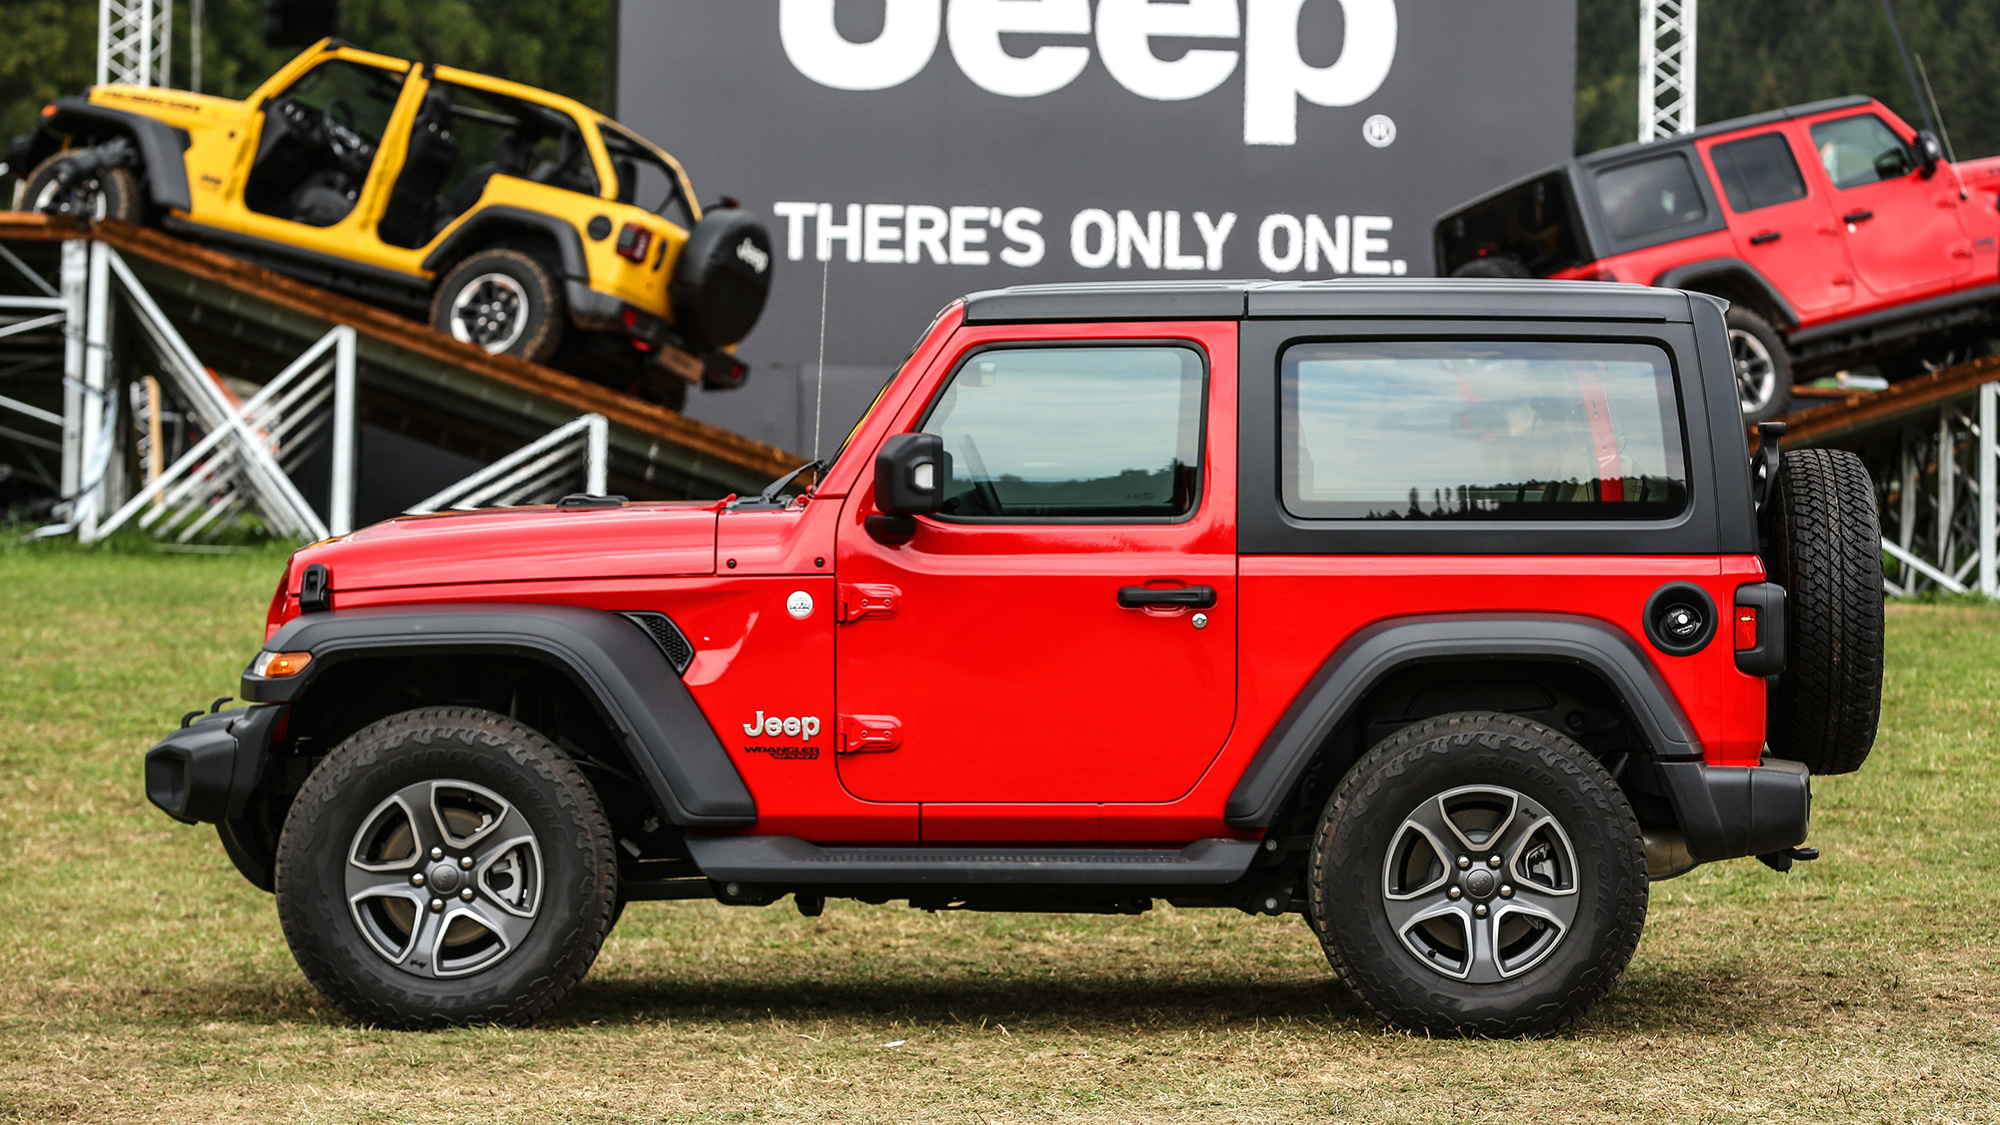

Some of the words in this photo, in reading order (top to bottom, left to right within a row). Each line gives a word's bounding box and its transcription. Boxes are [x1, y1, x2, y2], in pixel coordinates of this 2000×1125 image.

[736, 237, 769, 274] Jeep
[773, 201, 1046, 269] THERE'S
[1070, 208, 1238, 272] ONLY
[1257, 213, 1408, 276] ONE.
[743, 710, 820, 741] Jeep
[1472, 752, 1611, 928] BRIDGESTONE
[1350, 874, 1458, 1012] DUELER
